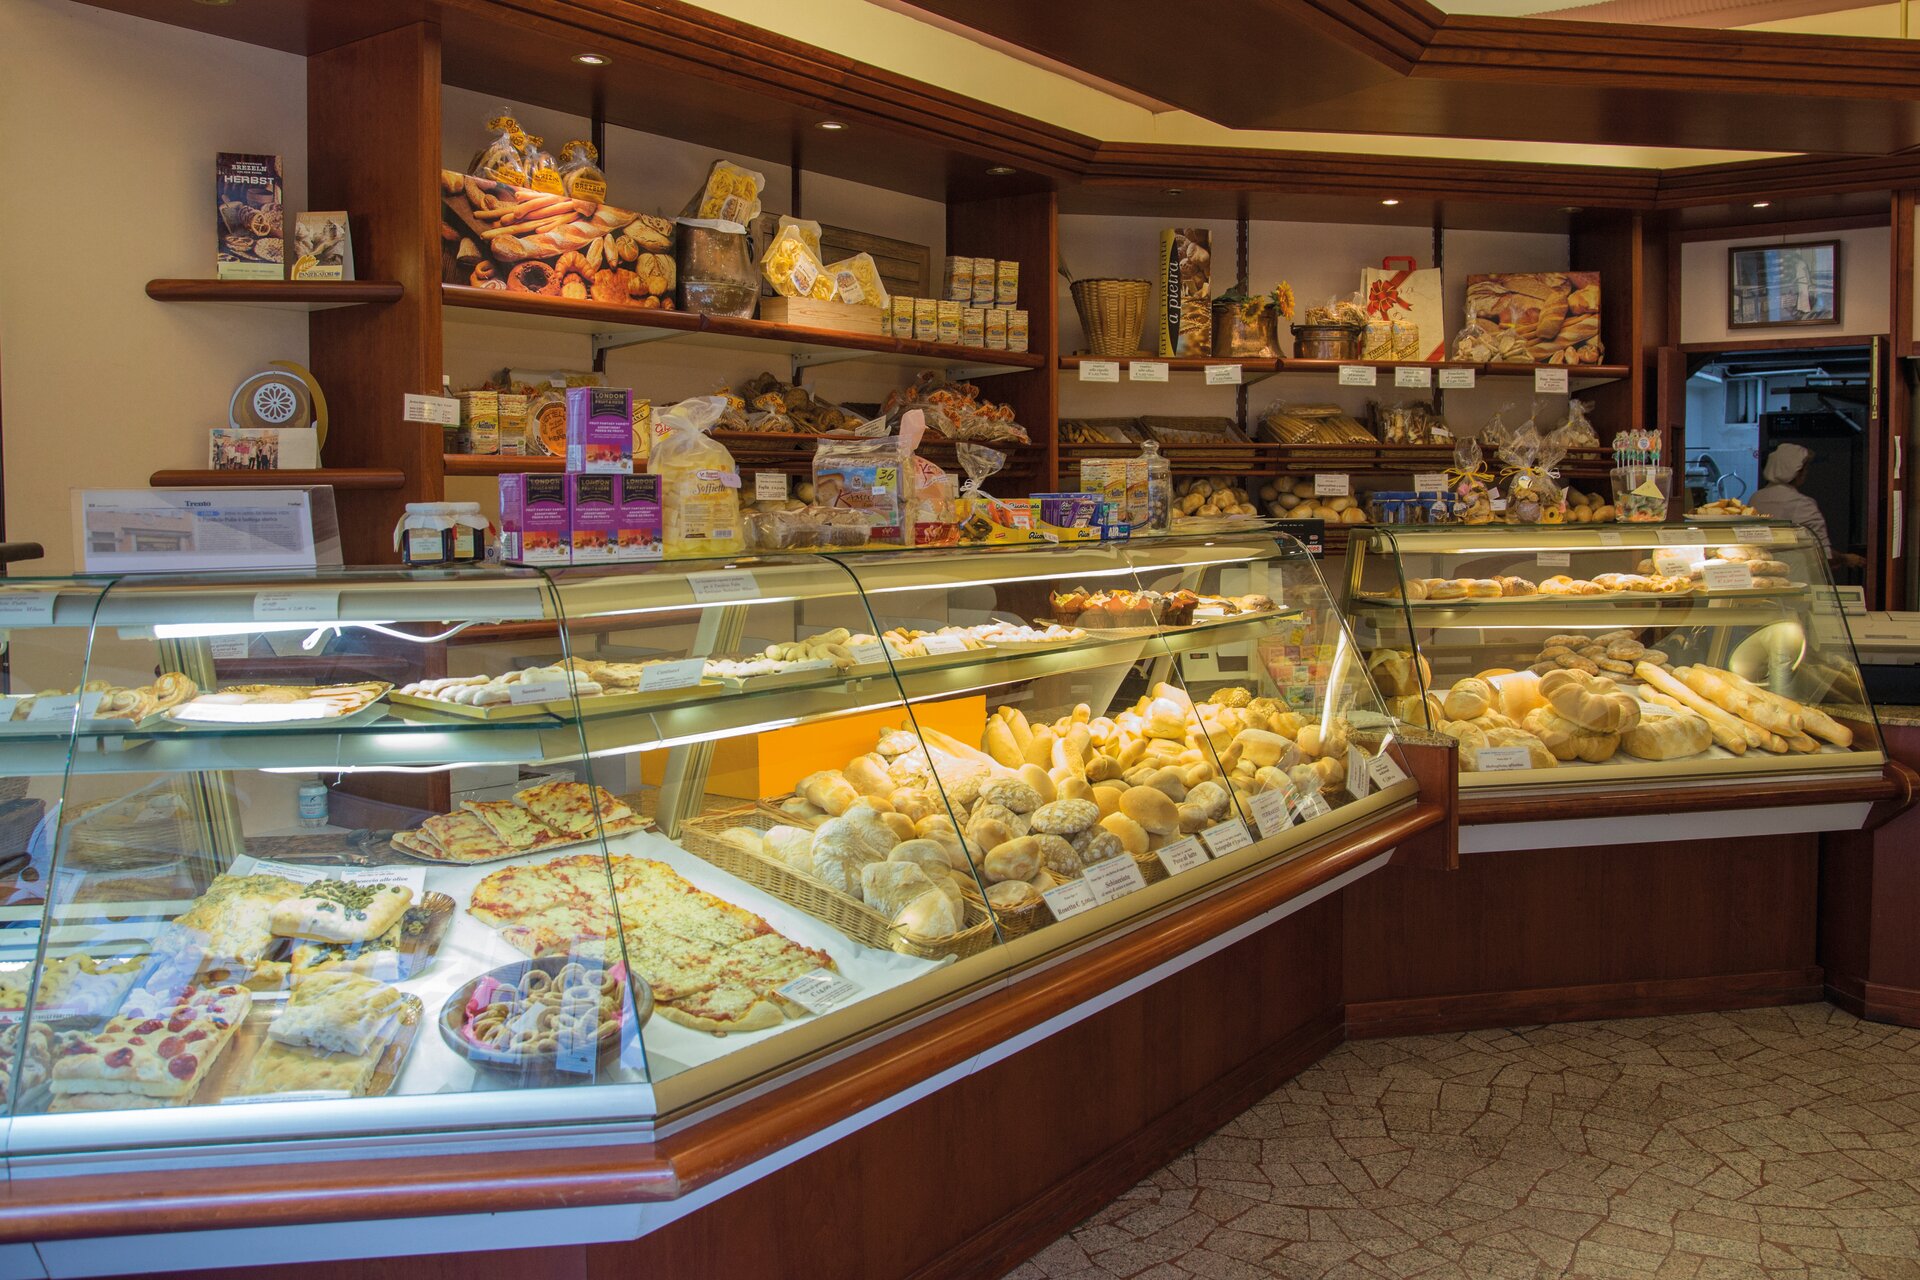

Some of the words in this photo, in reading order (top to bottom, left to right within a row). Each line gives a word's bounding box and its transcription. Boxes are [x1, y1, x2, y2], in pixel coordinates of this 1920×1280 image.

[231, 164, 267, 172] BREZELN
[224, 175, 275, 185] HERBST
[1167, 260, 1181, 310] pietra
[1168, 314, 1179, 324] a
[1159, 312, 1167, 356] farina
[878, 469, 895, 480] 36
[1108, 526, 1119, 537] AIR
